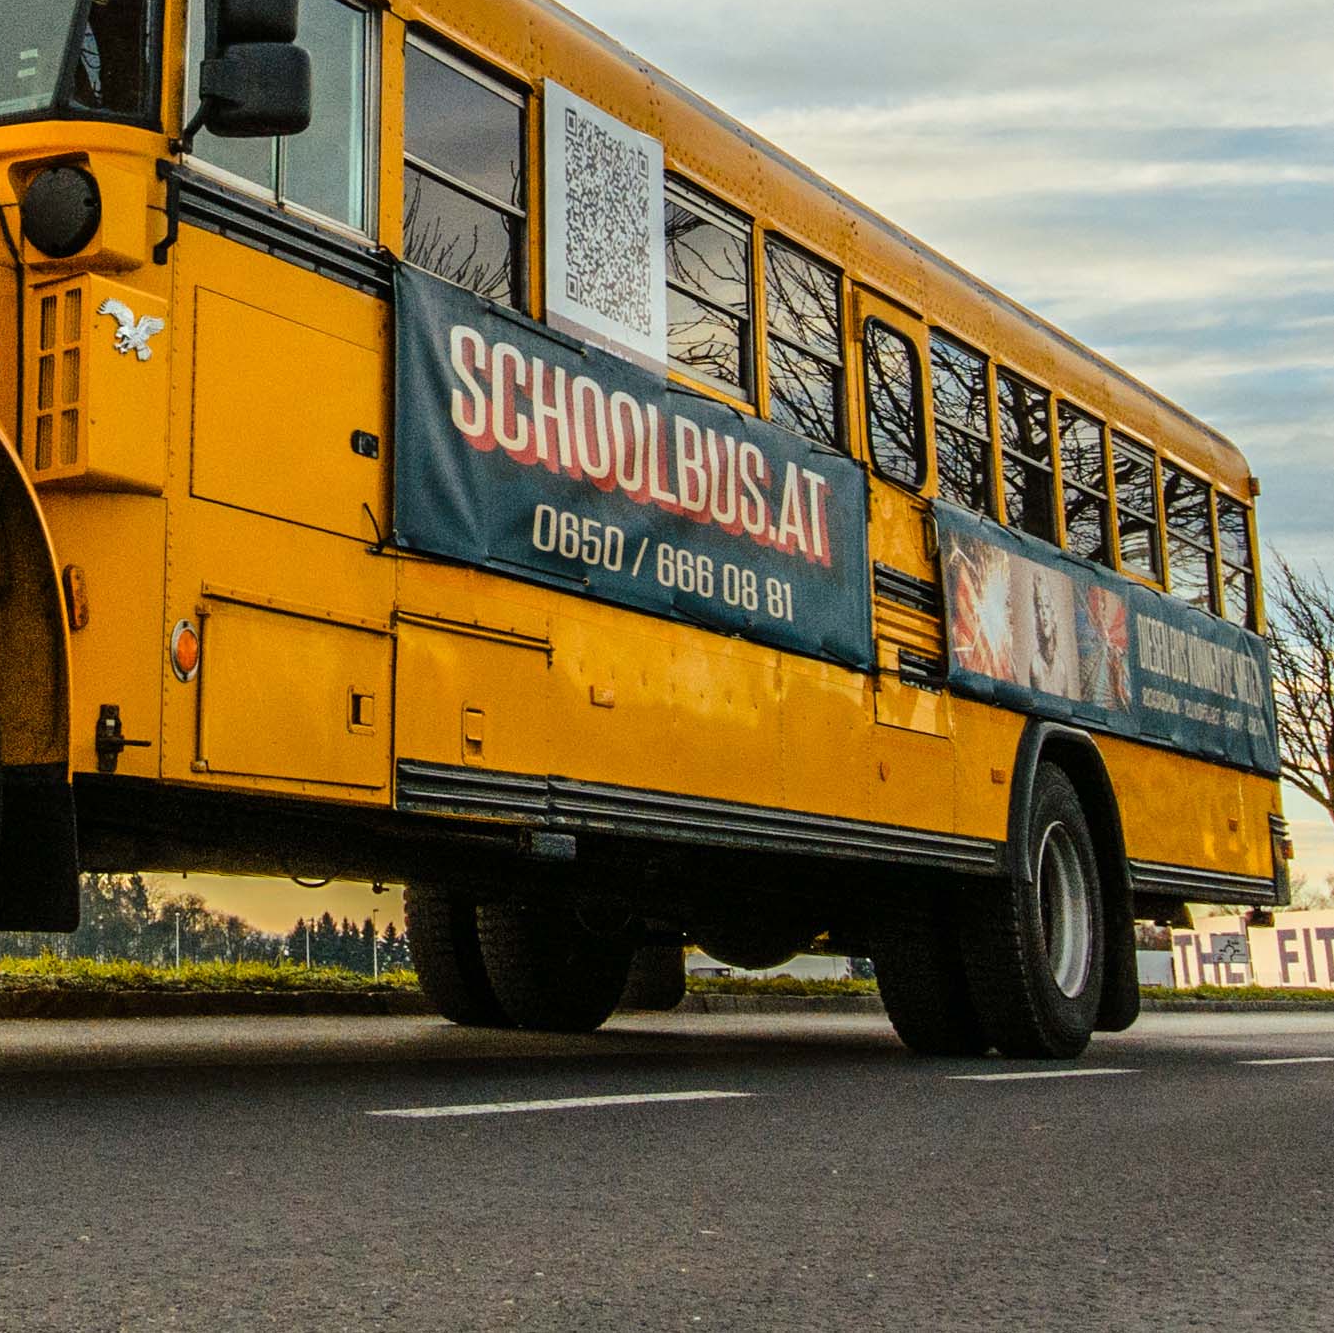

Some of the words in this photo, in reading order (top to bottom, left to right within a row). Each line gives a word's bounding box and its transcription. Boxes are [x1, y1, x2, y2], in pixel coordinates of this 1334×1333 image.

[450, 324, 827, 559] SCHOOLBUS.AT
[533, 504, 624, 571] 0650
[657, 542, 714, 598] 666
[723, 563, 758, 611] 08
[766, 577, 793, 622] 81
